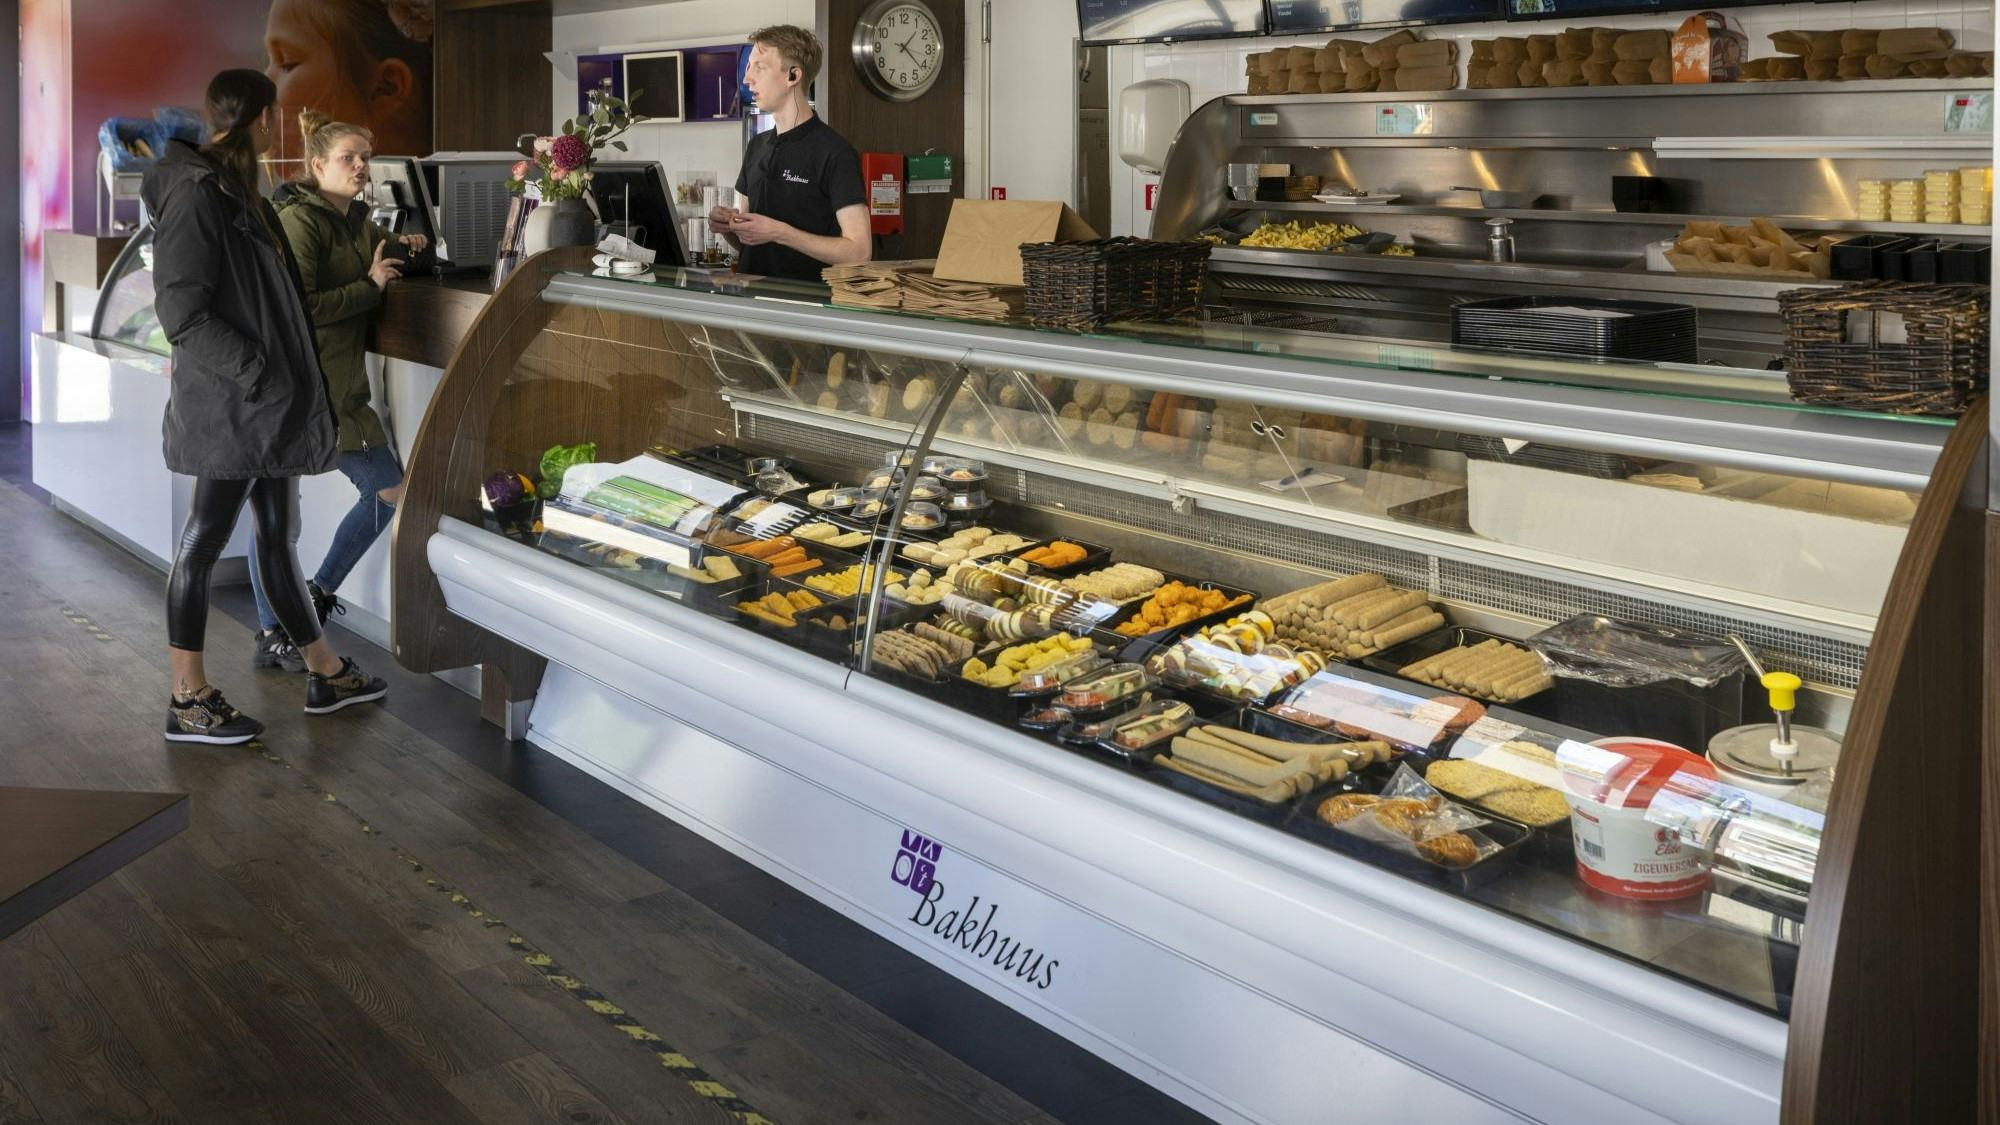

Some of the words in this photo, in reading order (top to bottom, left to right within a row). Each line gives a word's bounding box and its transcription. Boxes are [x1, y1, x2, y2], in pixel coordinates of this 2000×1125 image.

[888, 16, 895, 28] 11
[899, 13, 910, 25] 12
[878, 27, 889, 39] 10
[921, 28, 929, 40] 2
[874, 41, 882, 53] 9
[925, 44, 932, 55] 3
[878, 56, 886, 68] 8
[920, 59, 927, 69] 4
[889, 68, 896, 80] 7
[899, 72, 907, 84] 6
[911, 69, 919, 80] 5
[908, 880, 1060, 990] Bakhuus
